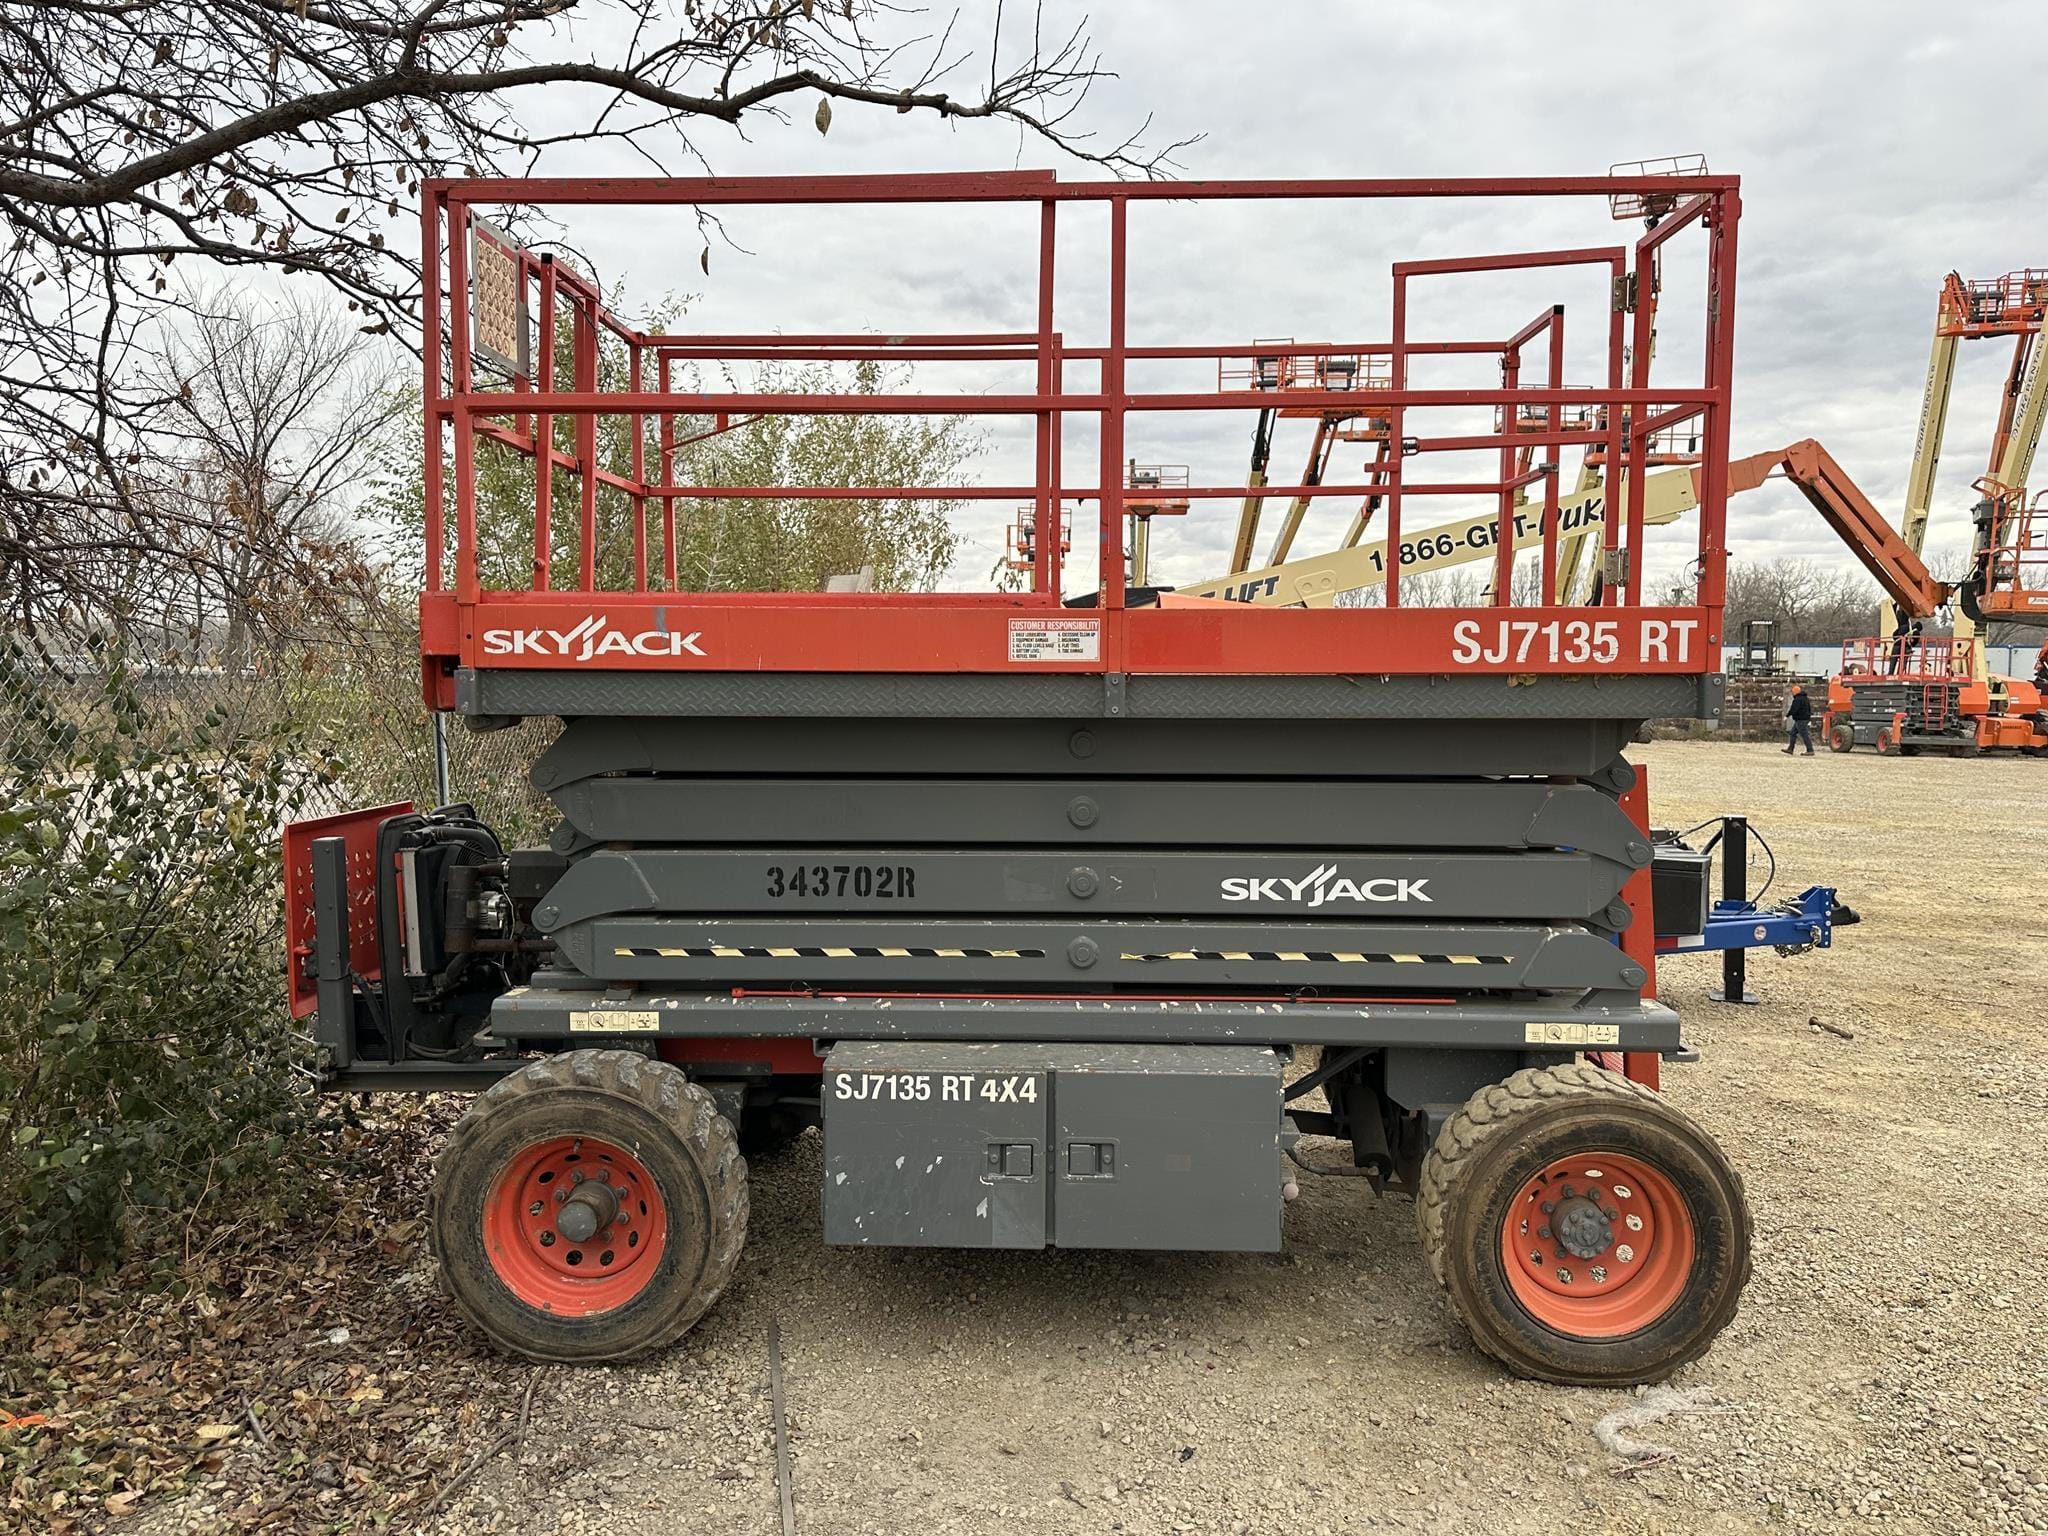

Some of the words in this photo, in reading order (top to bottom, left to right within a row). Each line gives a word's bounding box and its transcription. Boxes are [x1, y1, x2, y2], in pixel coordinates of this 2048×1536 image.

[1224, 575, 1280, 603] LIFT
[483, 614, 708, 662] SKYJACK
[1011, 621, 1046, 630] CUSTOMER
[1047, 621, 1098, 630] RESPONSIBILITY
[1452, 620, 1619, 664] SJ7135
[1639, 620, 1698, 664] RT
[767, 865, 915, 898] 343702R
[1220, 863, 1434, 908] SKYJACK
[835, 1073, 931, 1101] SJ7135
[942, 1075, 976, 1102] RT
[981, 1076, 1038, 1104] 4X4
